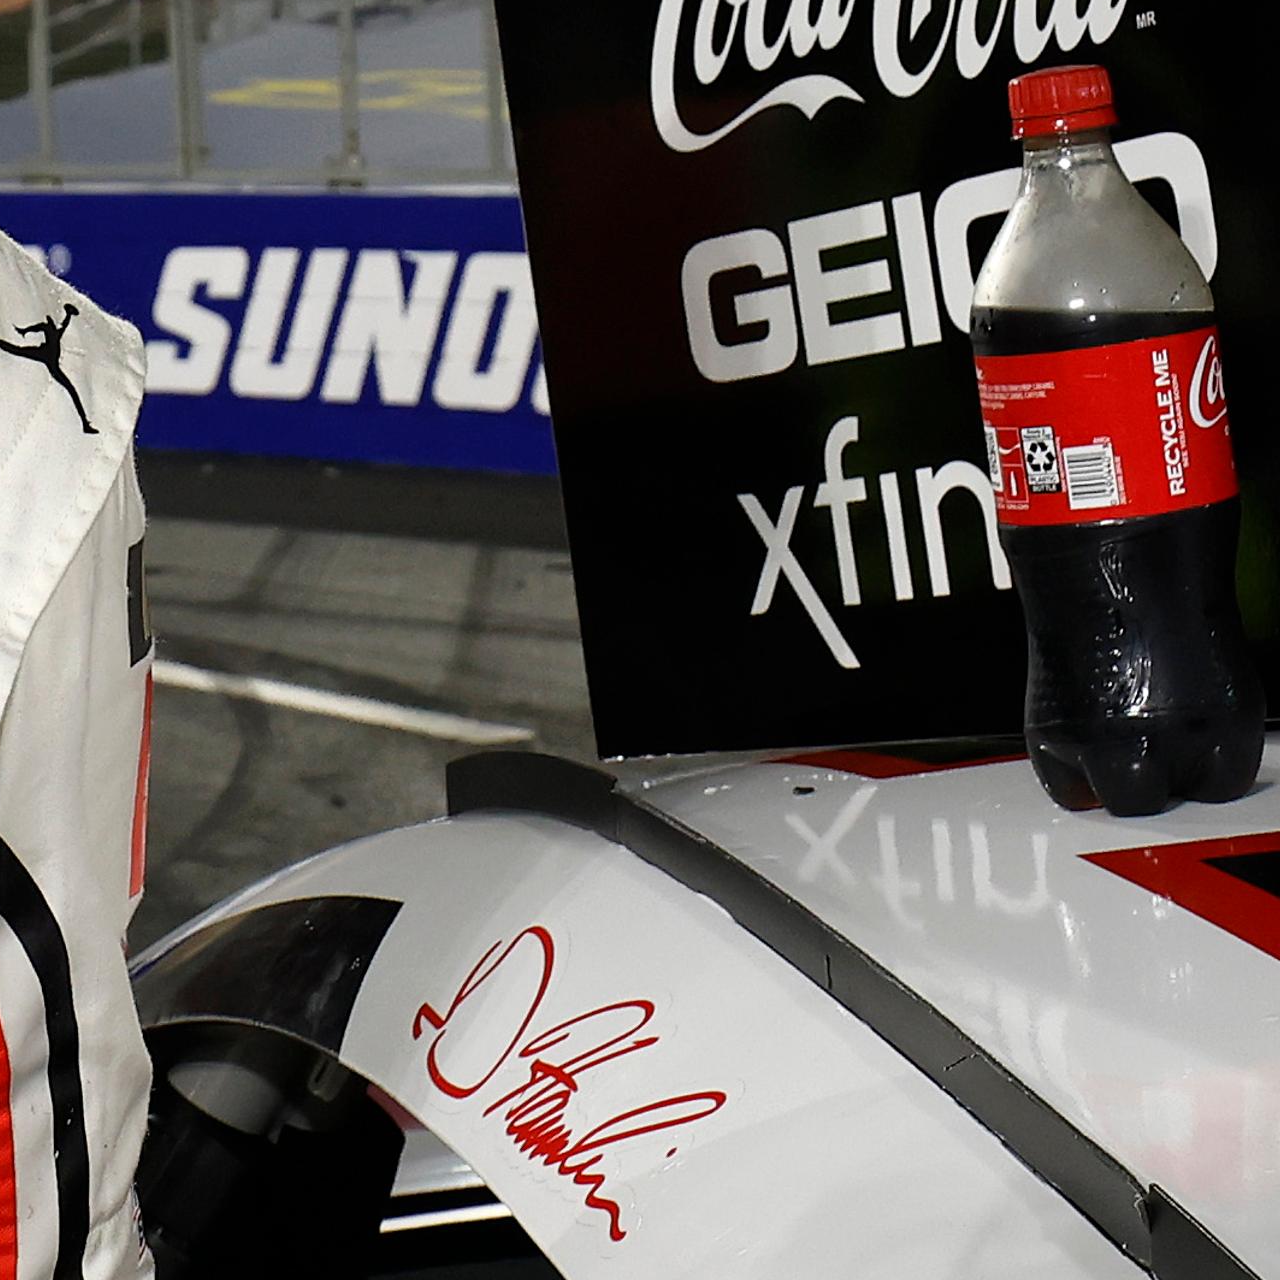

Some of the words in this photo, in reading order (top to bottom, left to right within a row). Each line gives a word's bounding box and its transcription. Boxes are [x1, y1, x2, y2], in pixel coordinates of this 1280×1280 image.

[145, 246, 551, 417] SUNO
[1152, 348, 1170, 387] ME
[1157, 391, 1186, 497] RECYCLE
